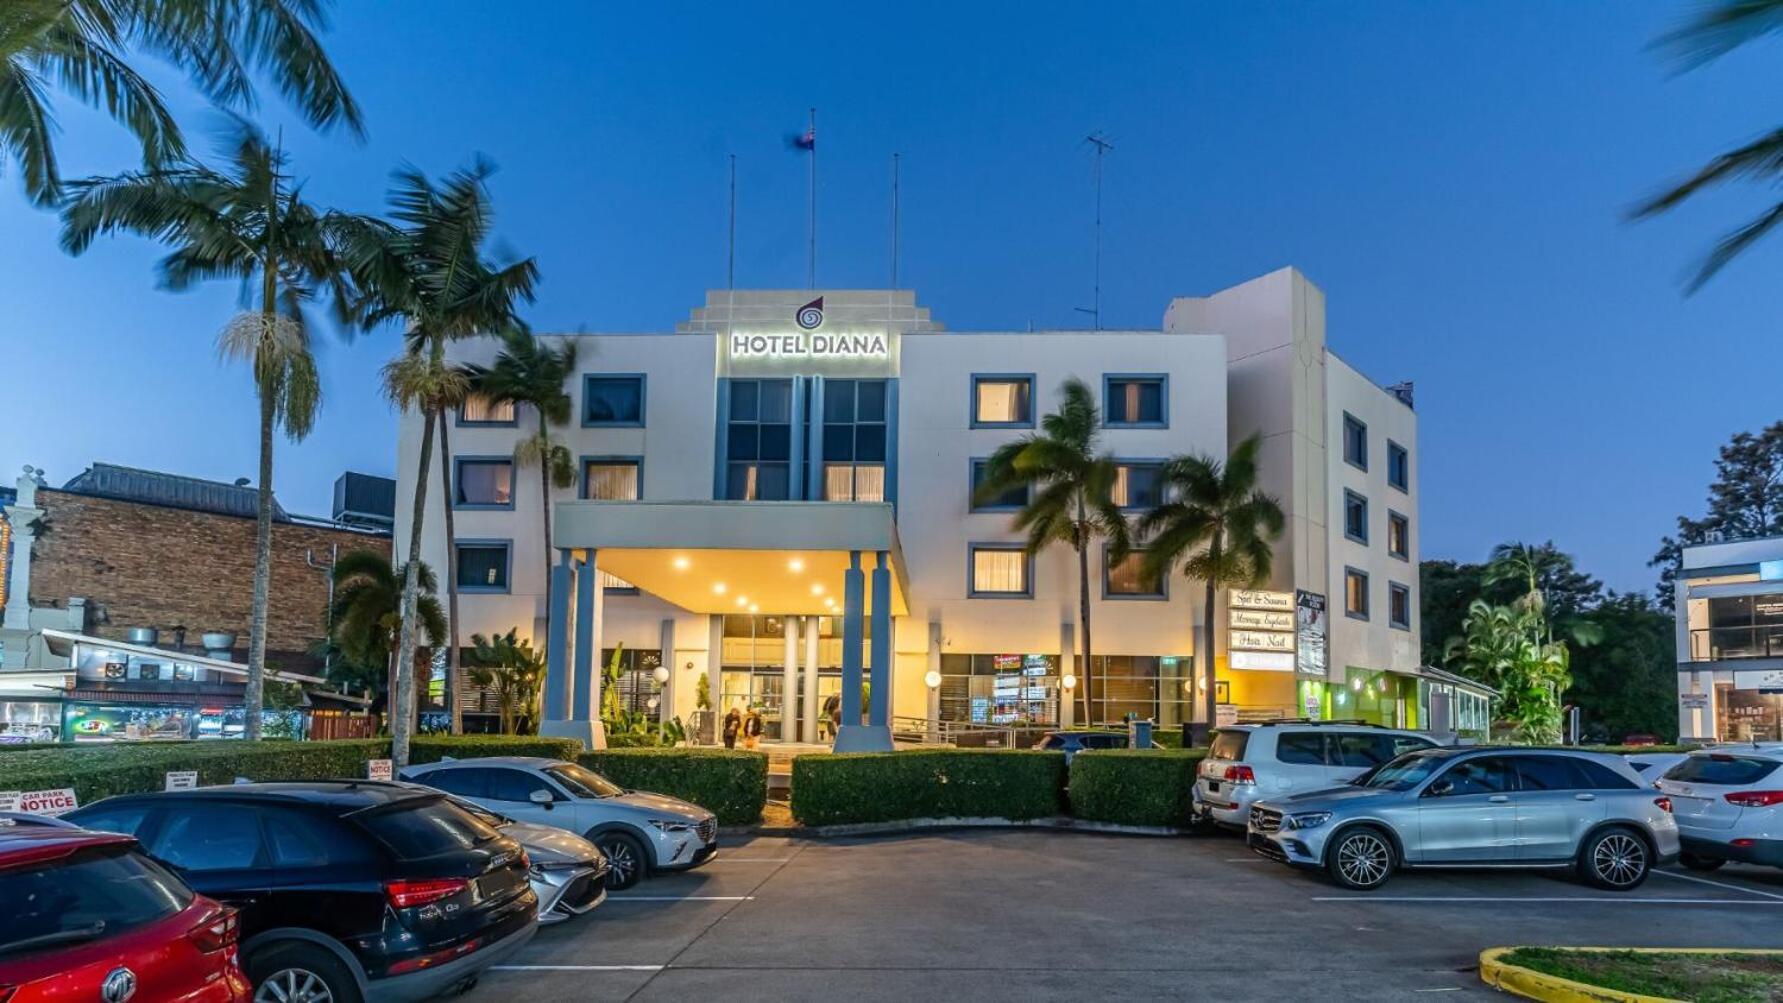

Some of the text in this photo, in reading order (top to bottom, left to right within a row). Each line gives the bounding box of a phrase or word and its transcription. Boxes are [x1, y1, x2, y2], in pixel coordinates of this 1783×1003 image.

[733, 335, 886, 354] HOTEL DIANA
[1264, 595, 1288, 606] Sauna
[1267, 635, 1286, 647] Nail
[22, 793, 40, 801] CAR
[42, 790, 66, 798] PARK
